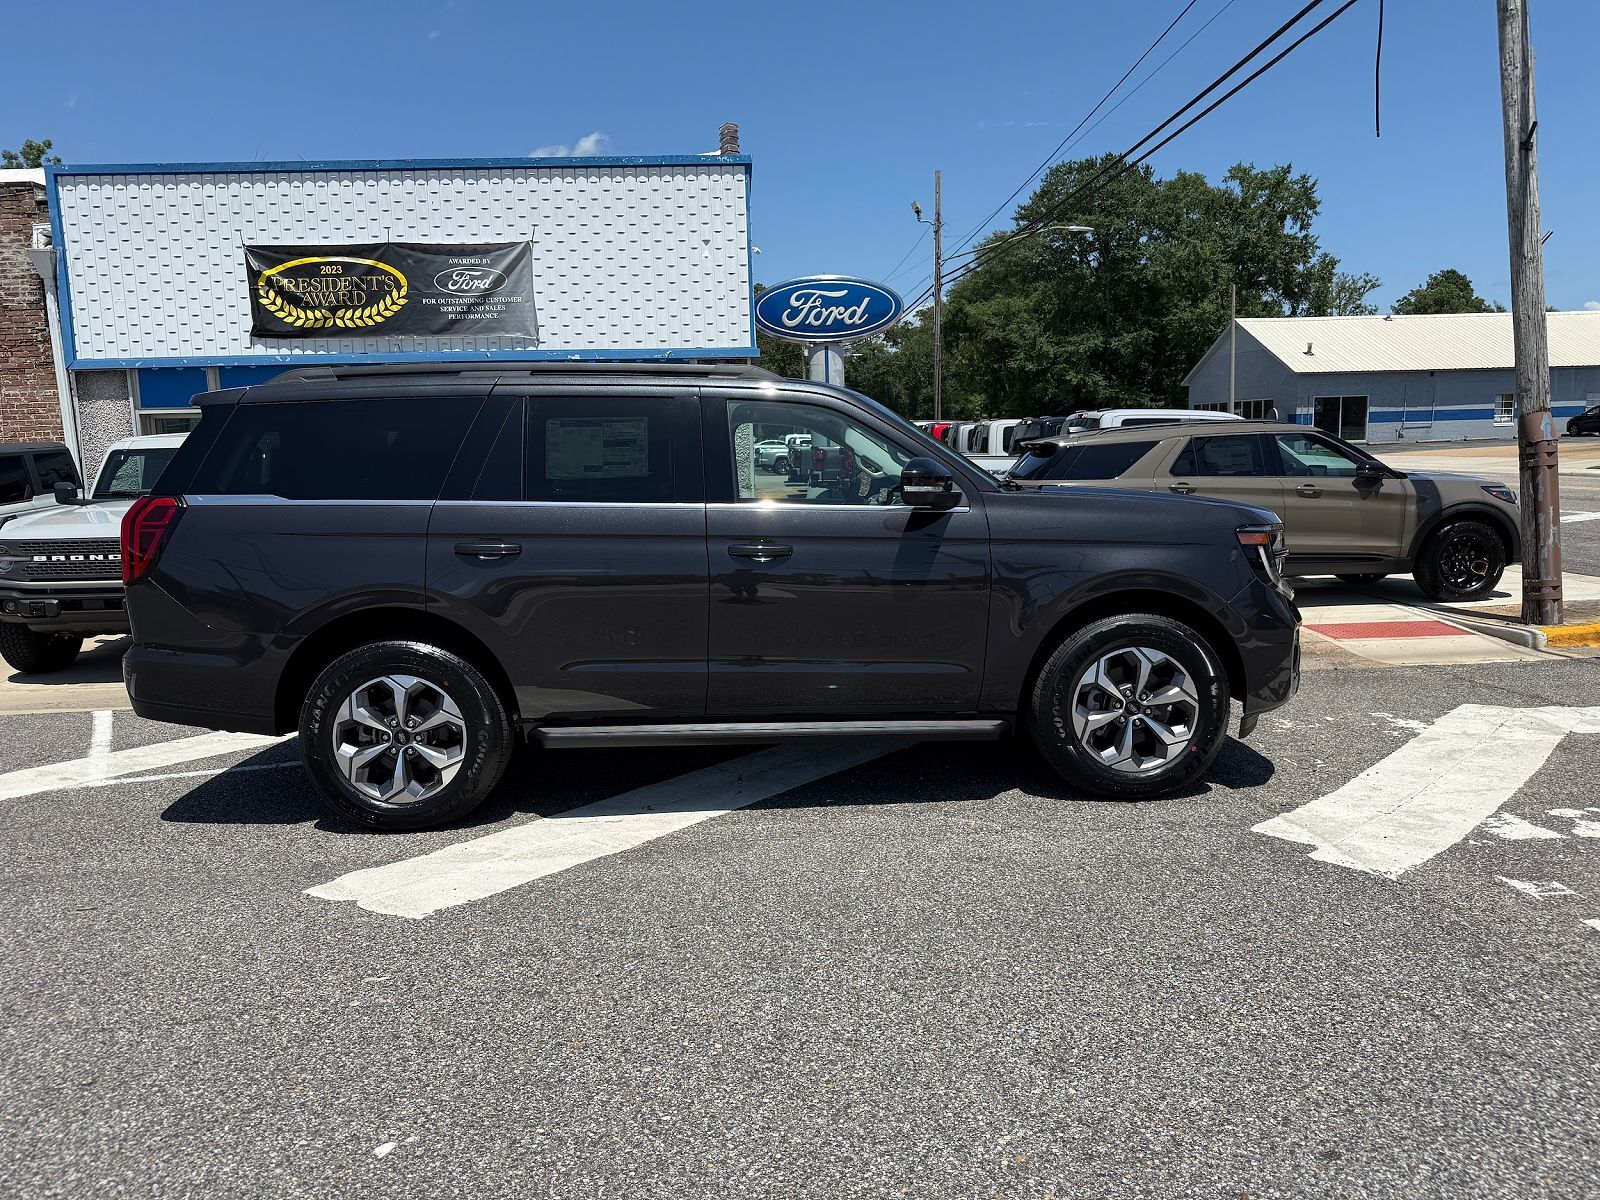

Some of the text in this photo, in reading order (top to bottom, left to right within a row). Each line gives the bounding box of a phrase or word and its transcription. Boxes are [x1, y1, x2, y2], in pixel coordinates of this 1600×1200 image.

[320, 265, 343, 275] 2023
[271, 275, 395, 293] PRESIDENT'S
[448, 270, 494, 290] Ford
[300, 290, 366, 306] AWARD
[781, 289, 871, 327] Ford
